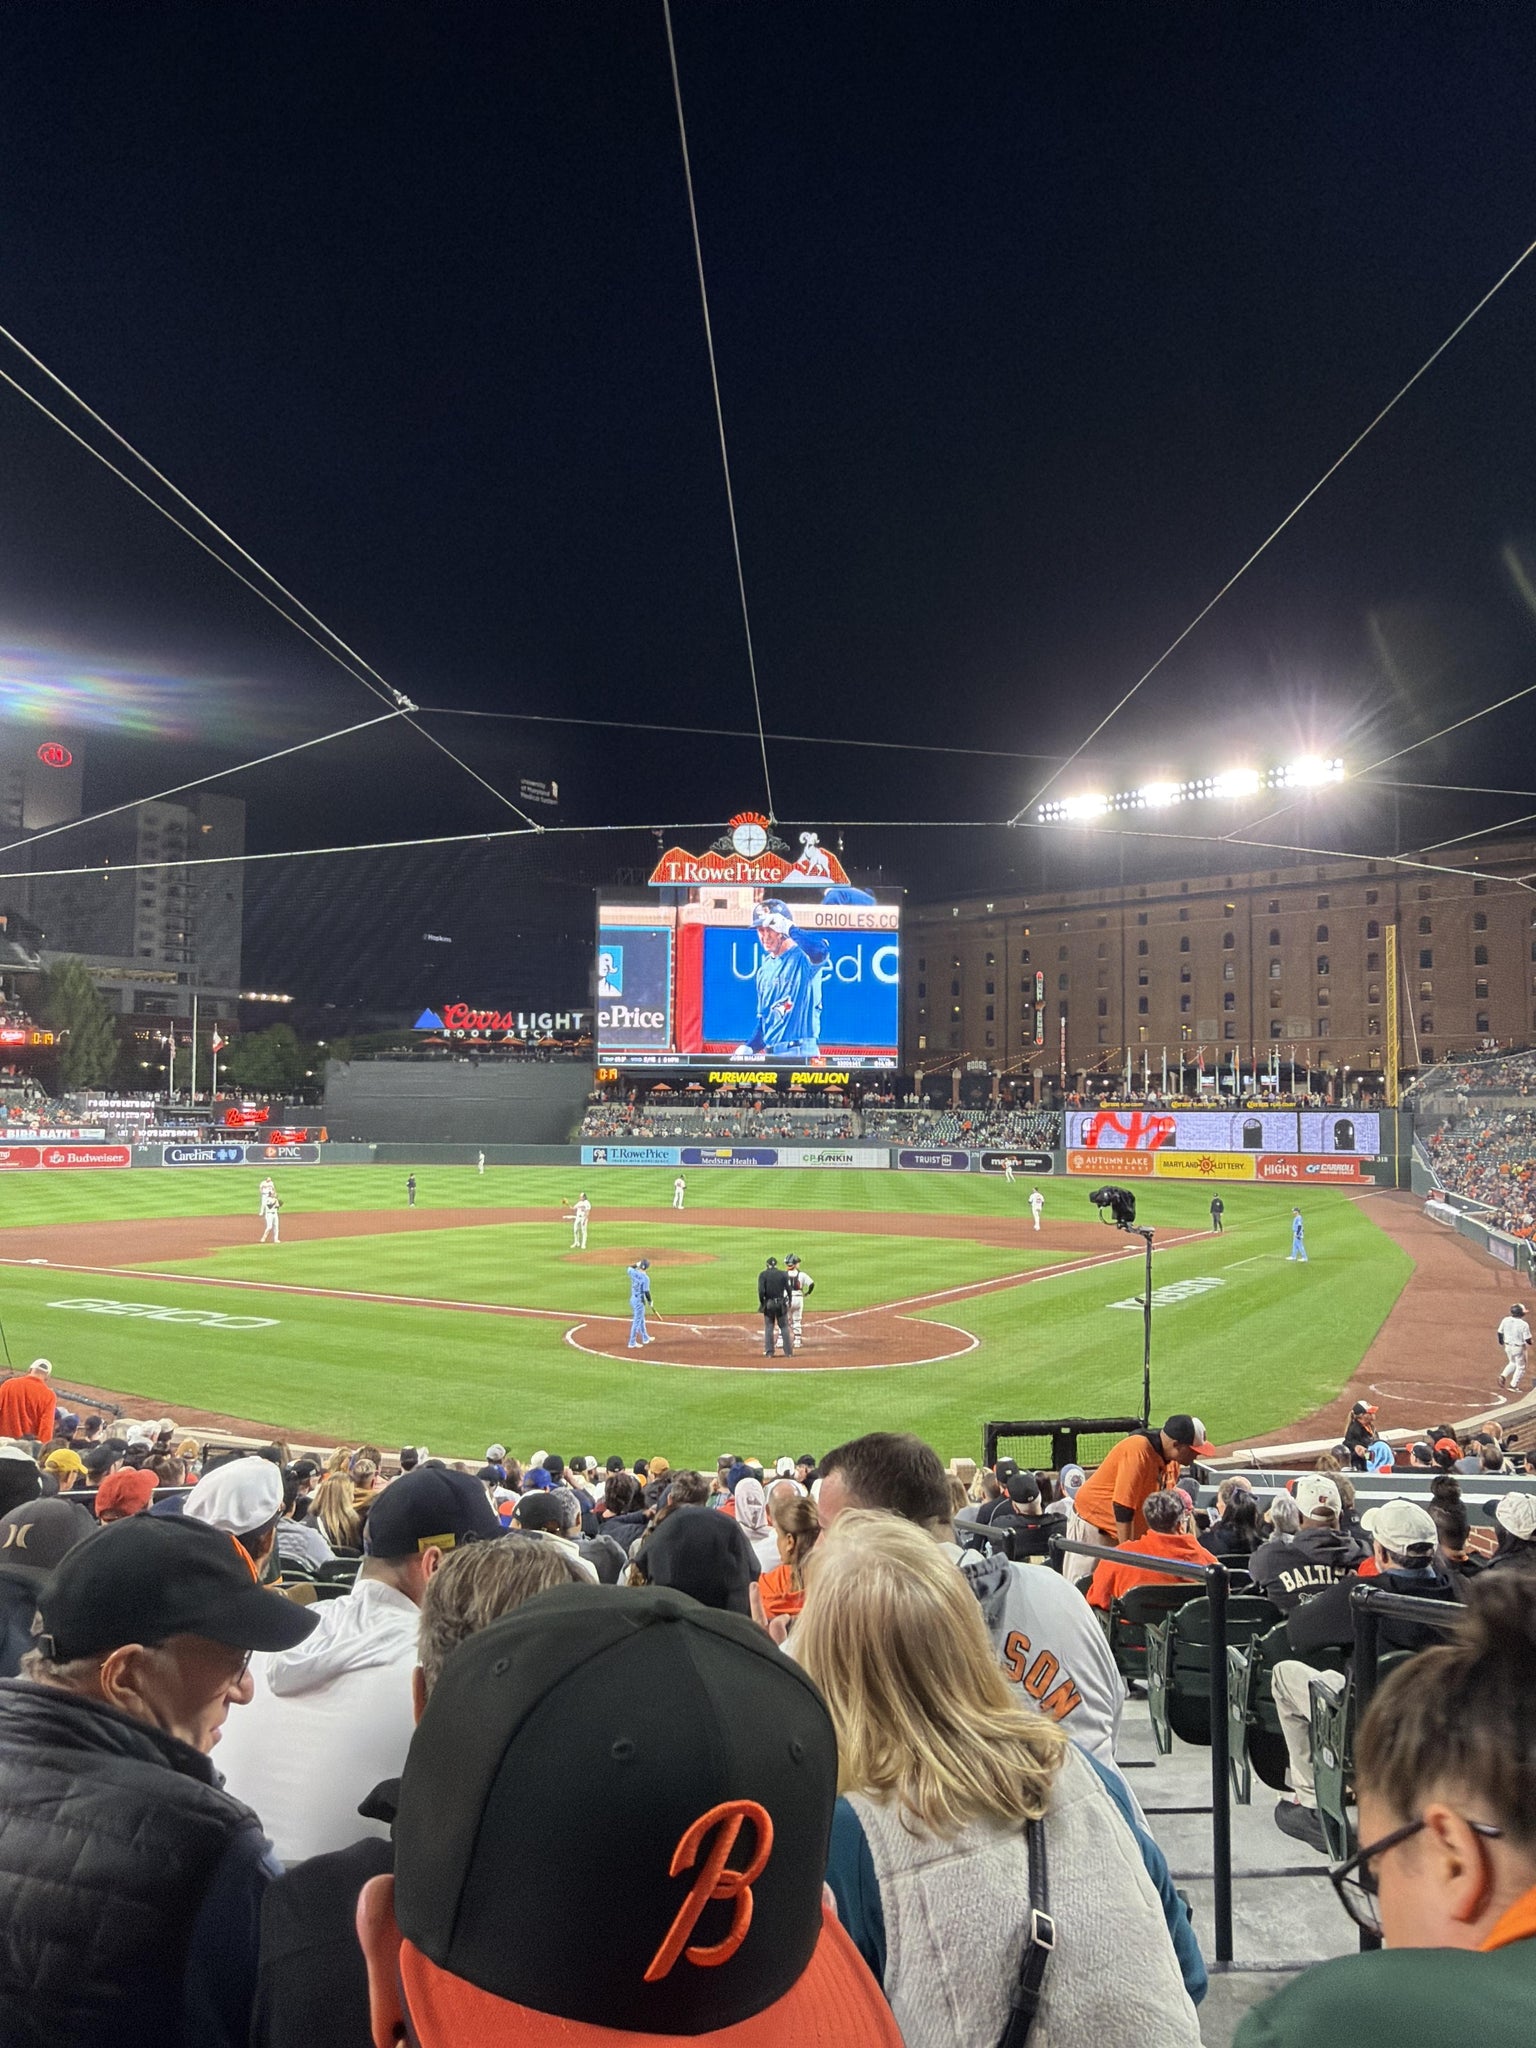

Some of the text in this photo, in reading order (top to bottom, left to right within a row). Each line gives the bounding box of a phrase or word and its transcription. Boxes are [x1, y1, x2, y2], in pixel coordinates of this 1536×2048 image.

[727, 811, 771, 829] ORIOLES
[443, 1003, 583, 1030] Coors LIGHT
[444, 1029, 554, 1038] ROOF DECK
[709, 1071, 849, 1084] PUREWAGER PAVILION
[7, 1128, 71, 1138] BIRD BATH
[67, 1152, 124, 1163] Budweiser
[171, 1149, 216, 1162] CareFirst
[278, 1147, 301, 1157] PNC
[701, 1157, 758, 1165] MedStar Health
[915, 1155, 941, 1164] TRUIST
[1086, 1157, 1148, 1166] AUTUMN LAKE
[1163, 1161, 1198, 1169] MARYLAND
[1264, 1164, 1298, 1177] HIGH'S
[46, 1298, 281, 1329] GEICO
[643, 1799, 774, 1982] B
